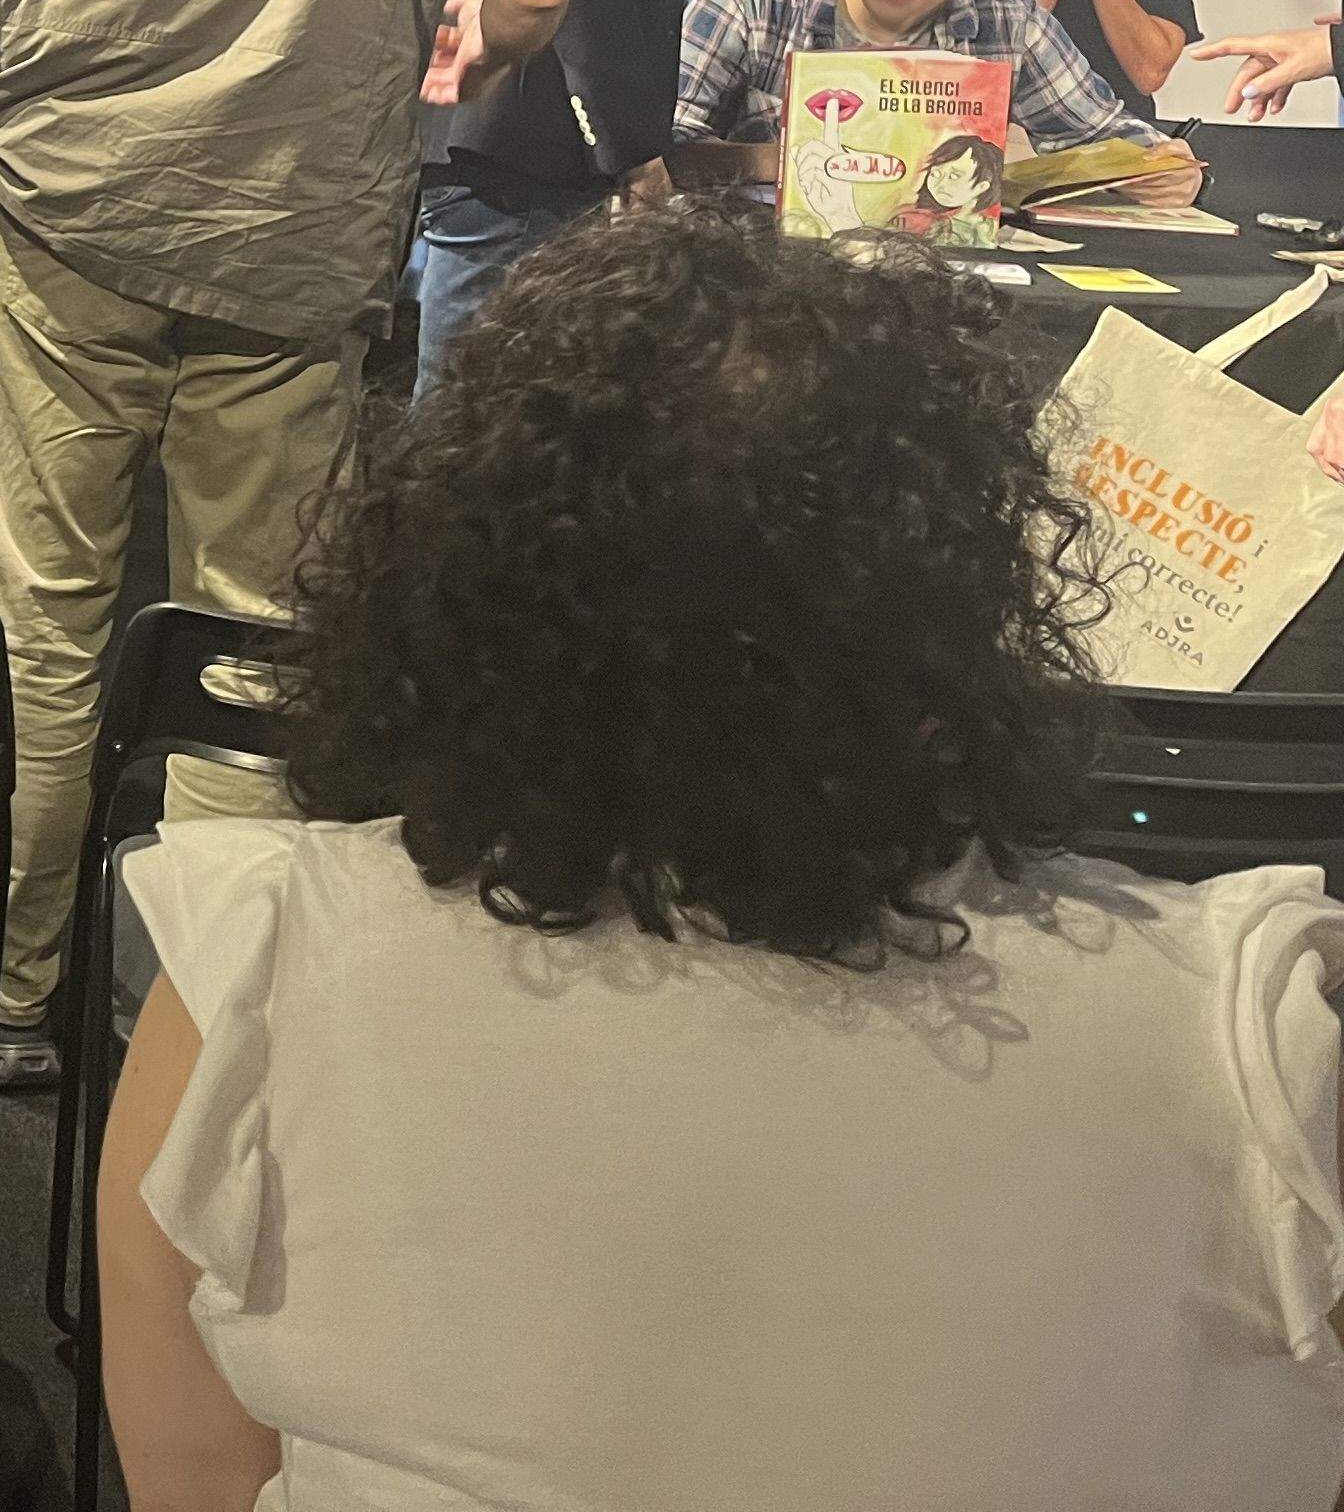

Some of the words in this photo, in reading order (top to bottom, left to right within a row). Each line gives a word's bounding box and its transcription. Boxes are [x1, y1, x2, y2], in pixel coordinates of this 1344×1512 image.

[880, 79, 896, 94] EL
[1091, 436, 1255, 544] INCLUSIÓ
[1128, 548, 1243, 624] correcte!
[1140, 620, 1203, 666] ADJRA
